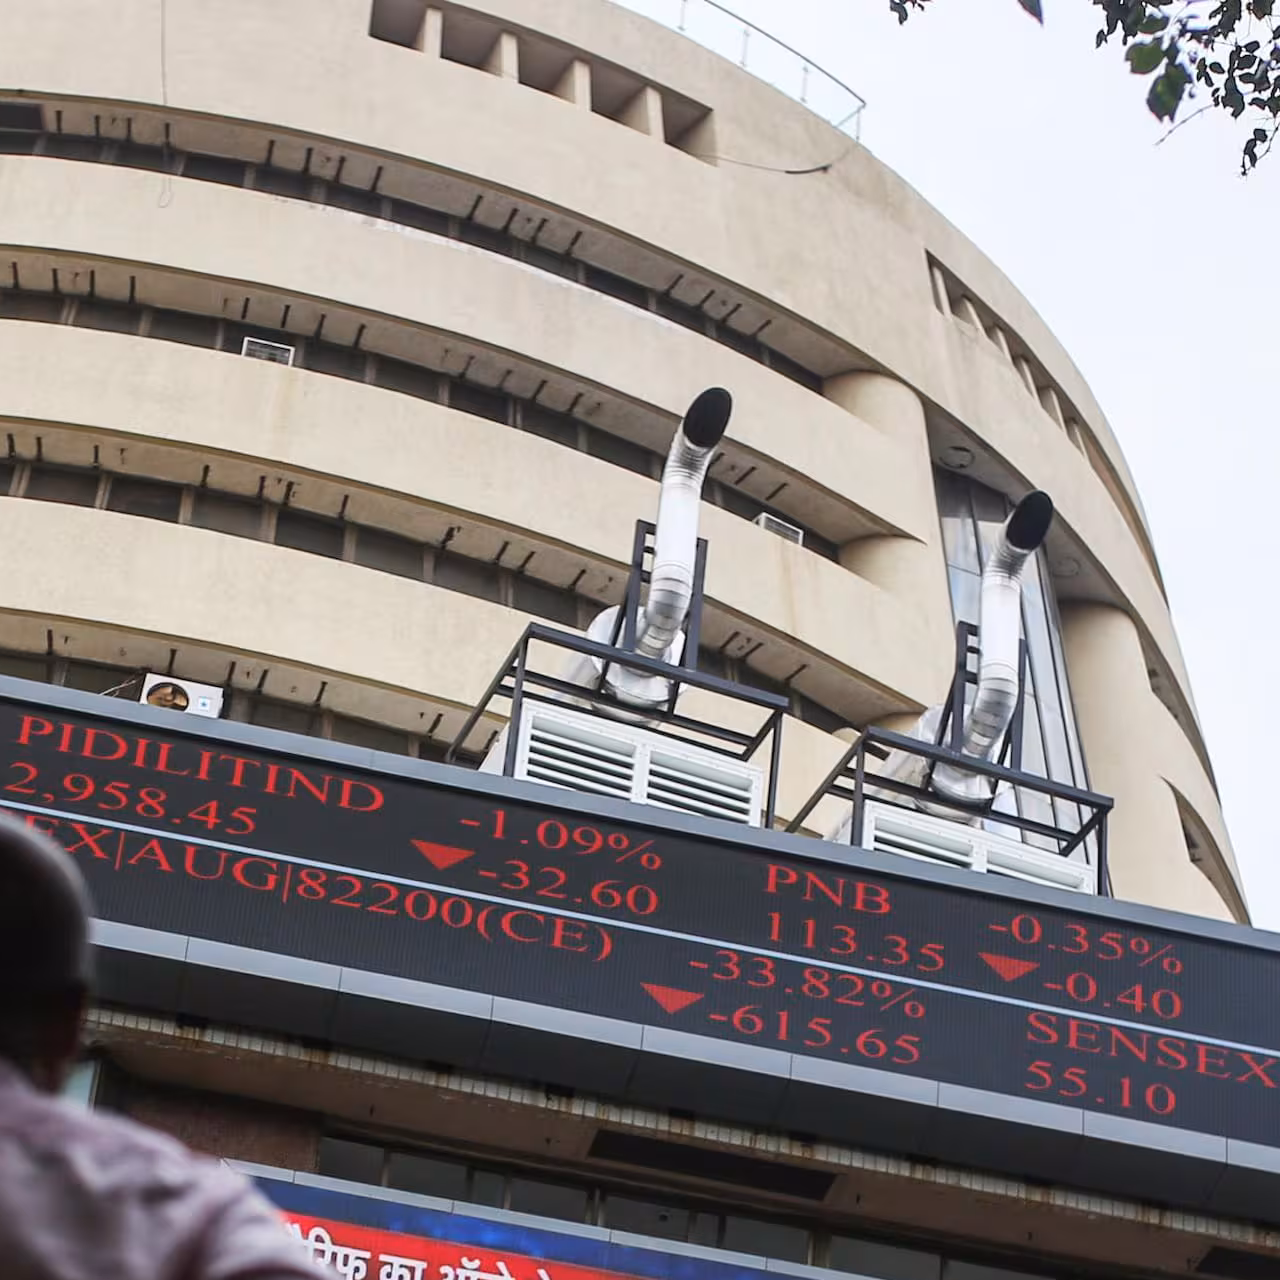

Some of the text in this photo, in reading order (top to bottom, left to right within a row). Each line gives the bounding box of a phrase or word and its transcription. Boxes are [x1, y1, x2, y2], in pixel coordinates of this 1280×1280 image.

[16, 714, 384, 812] PIDILITIND
[4, 760, 256, 834] 2,958.45
[460, 808, 662, 870] -1.09%
[480, 860, 658, 914] -32.60
[768, 864, 892, 914] PNB
[770, 912, 944, 972] 113.35
[988, 914, 1184, 974] -0.35%
[688, 950, 926, 1018] -33.82%
[1044, 972, 1182, 1018] -0.40
[710, 1006, 920, 1064] -615.65
[1026, 1060, 1176, 1114] 55.10
